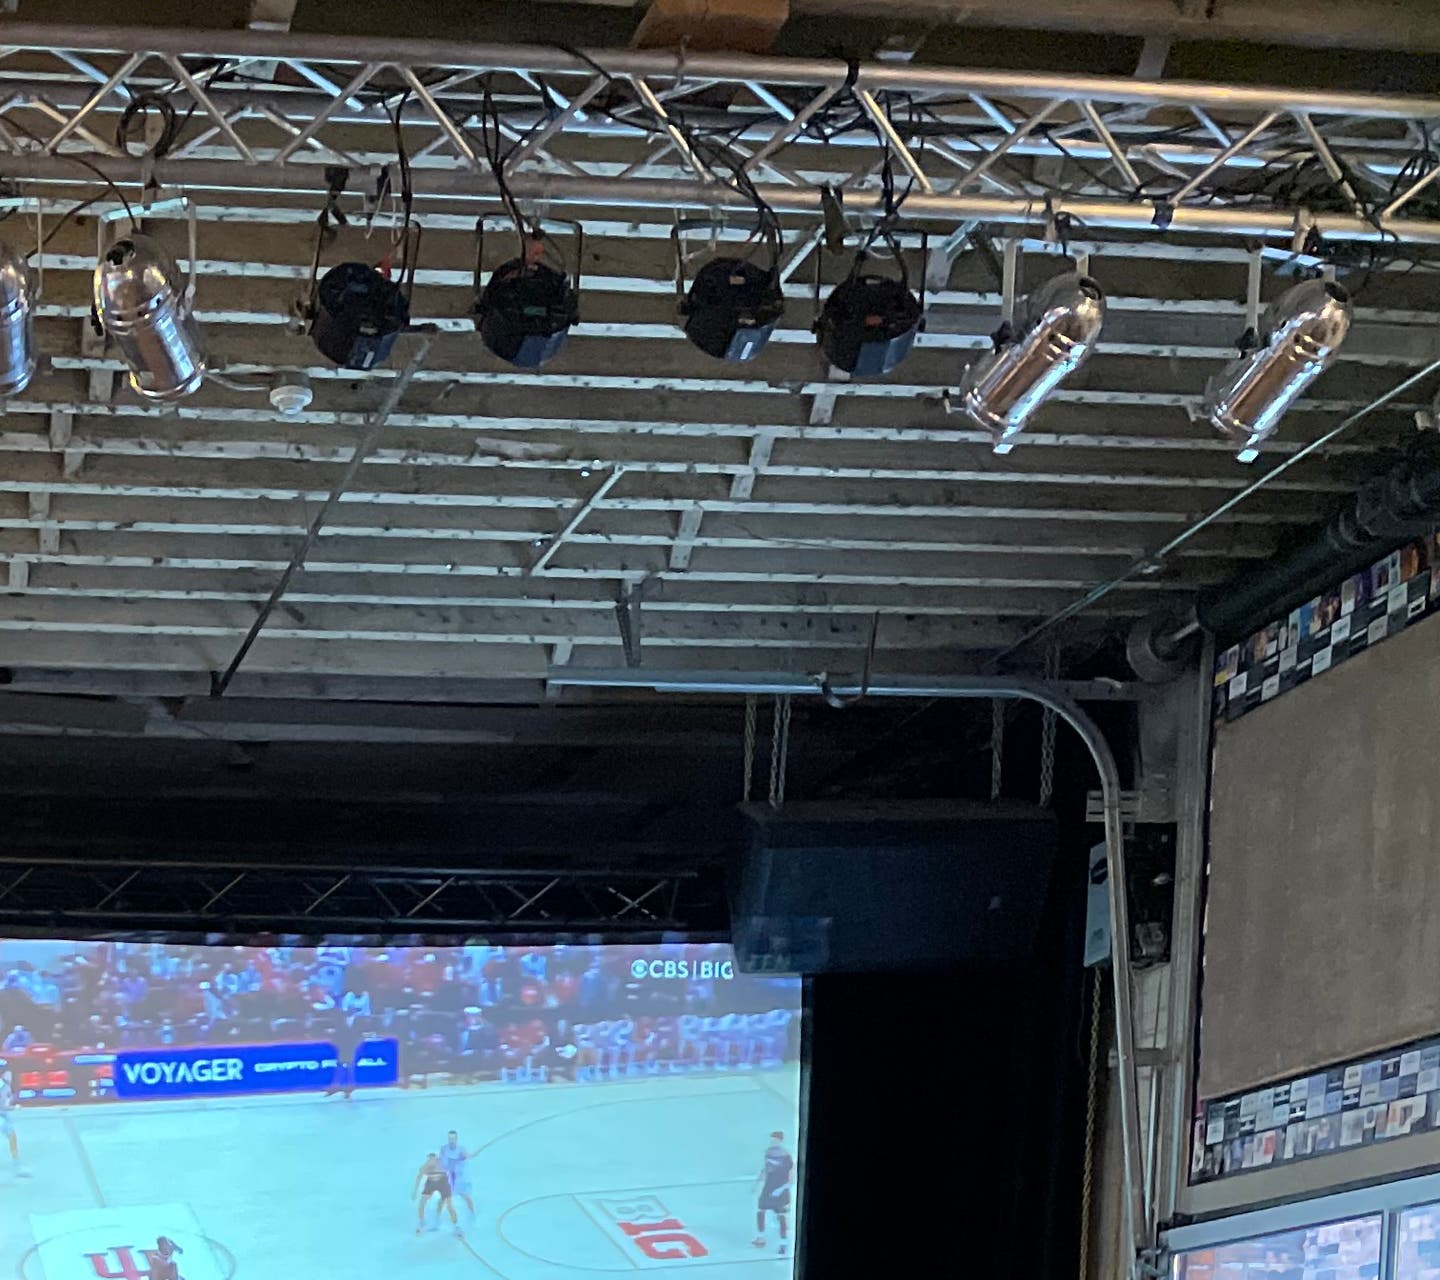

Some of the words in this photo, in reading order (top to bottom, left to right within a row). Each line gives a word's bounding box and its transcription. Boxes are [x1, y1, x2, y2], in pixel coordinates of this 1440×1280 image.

[649, 959, 689, 979] CBS
[700, 961, 734, 980] BIG
[122, 1058, 244, 1085] VOYAGER
